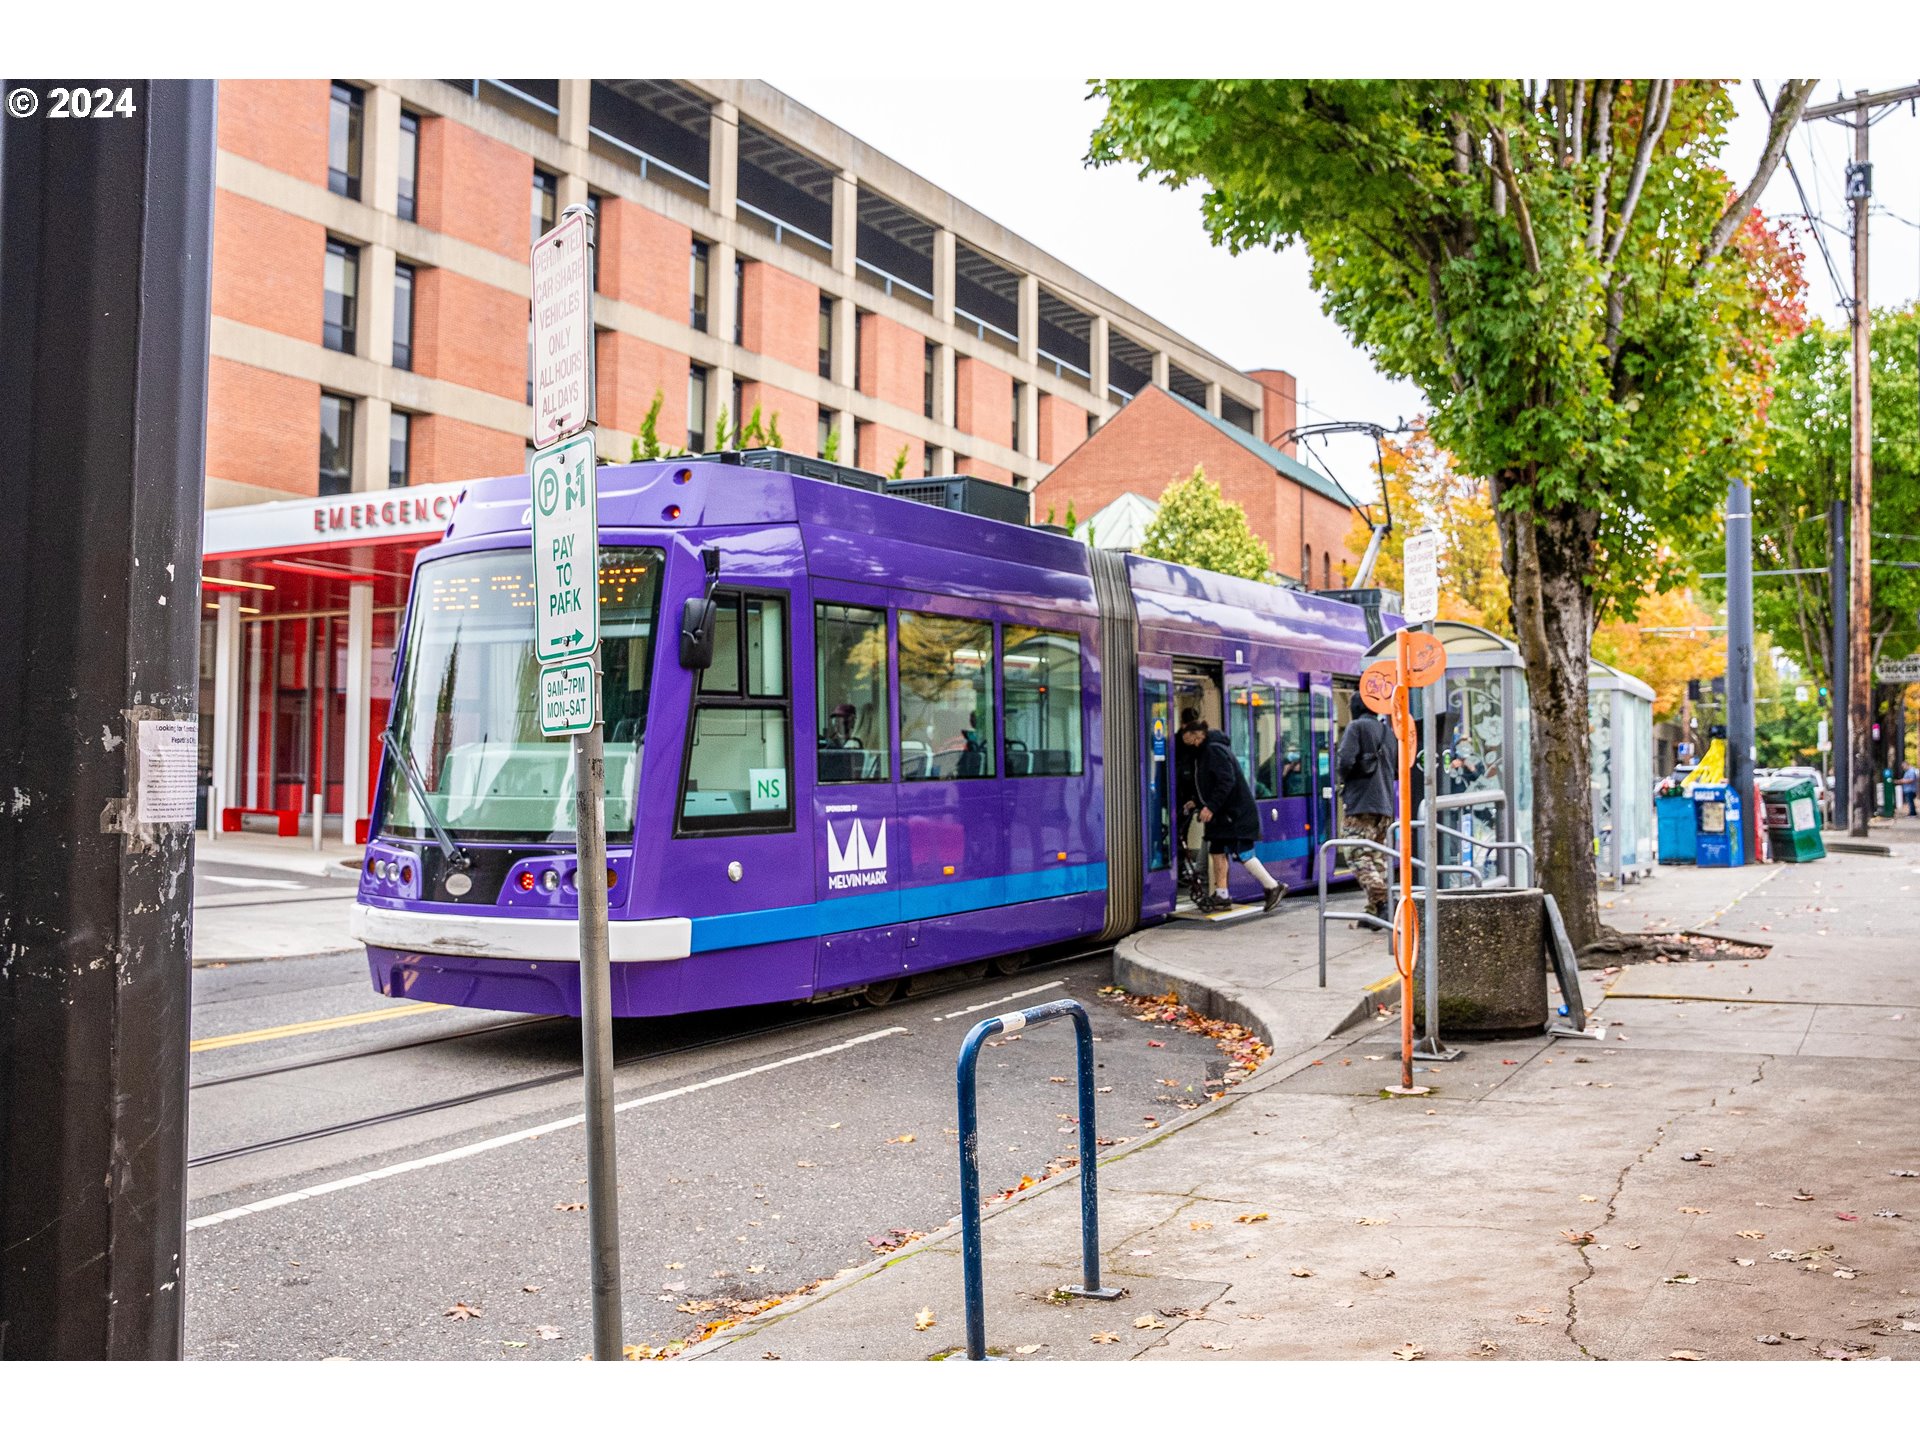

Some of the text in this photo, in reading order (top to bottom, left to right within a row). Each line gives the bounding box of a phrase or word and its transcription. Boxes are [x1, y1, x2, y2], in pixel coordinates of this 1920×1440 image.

[536, 229, 581, 275] PERMITTED
[536, 257, 583, 304] CAR SHARE
[539, 290, 579, 331] VEHICLES
[548, 326, 571, 356] ONLY
[540, 350, 582, 390] ALL HOURS
[542, 380, 579, 417] ALL DAYS
[314, 495, 460, 531] EMERGENCY
[552, 533, 575, 562] PAY
[556, 562, 573, 587] TO
[547, 676, 585, 698] 9AM-7PM
[547, 697, 586, 718] MON-SAT
[758, 779, 780, 798] NS
[829, 870, 888, 890] MELVIN MARK
